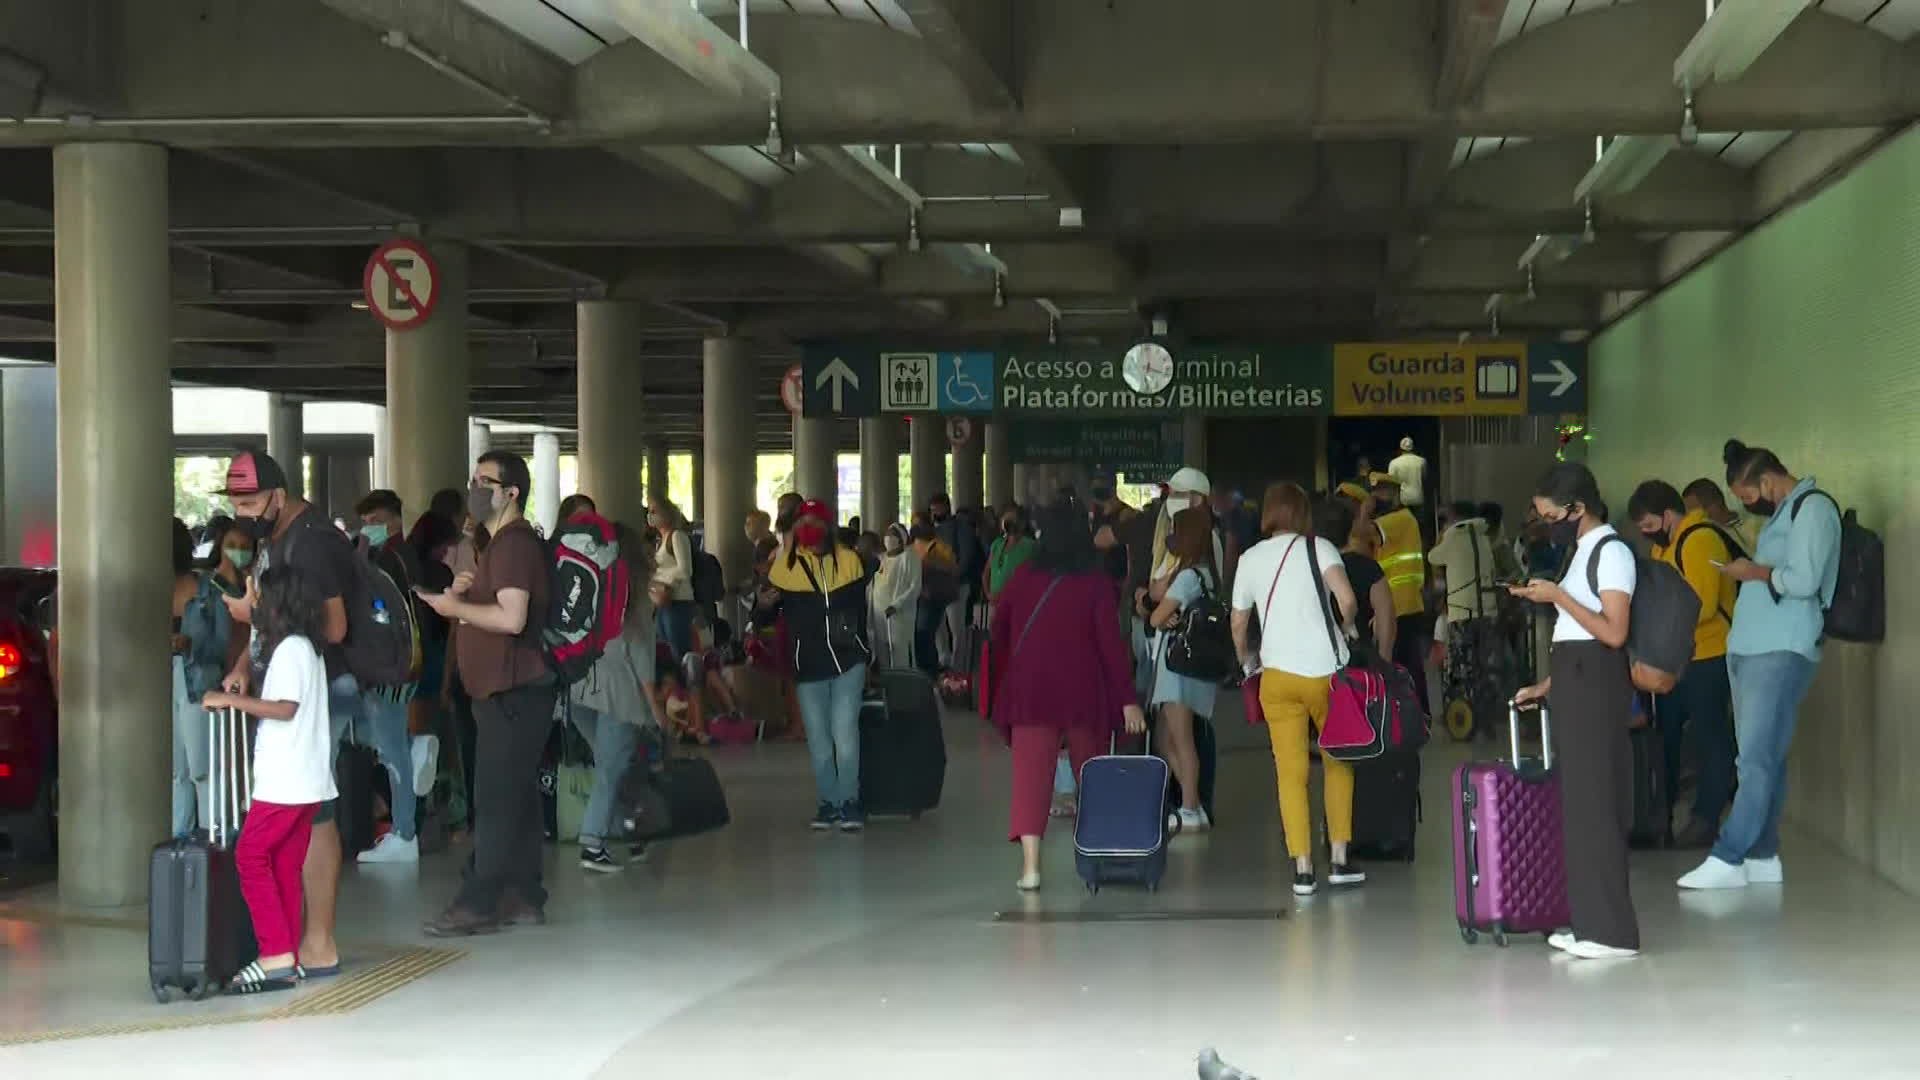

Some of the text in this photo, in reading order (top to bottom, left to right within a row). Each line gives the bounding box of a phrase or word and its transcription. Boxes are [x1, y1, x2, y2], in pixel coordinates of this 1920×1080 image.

[1003, 357, 1093, 379] Acesso
[1176, 355, 1261, 378] rminal
[1368, 353, 1465, 374] Guarda
[1352, 381, 1465, 405] Volumes
